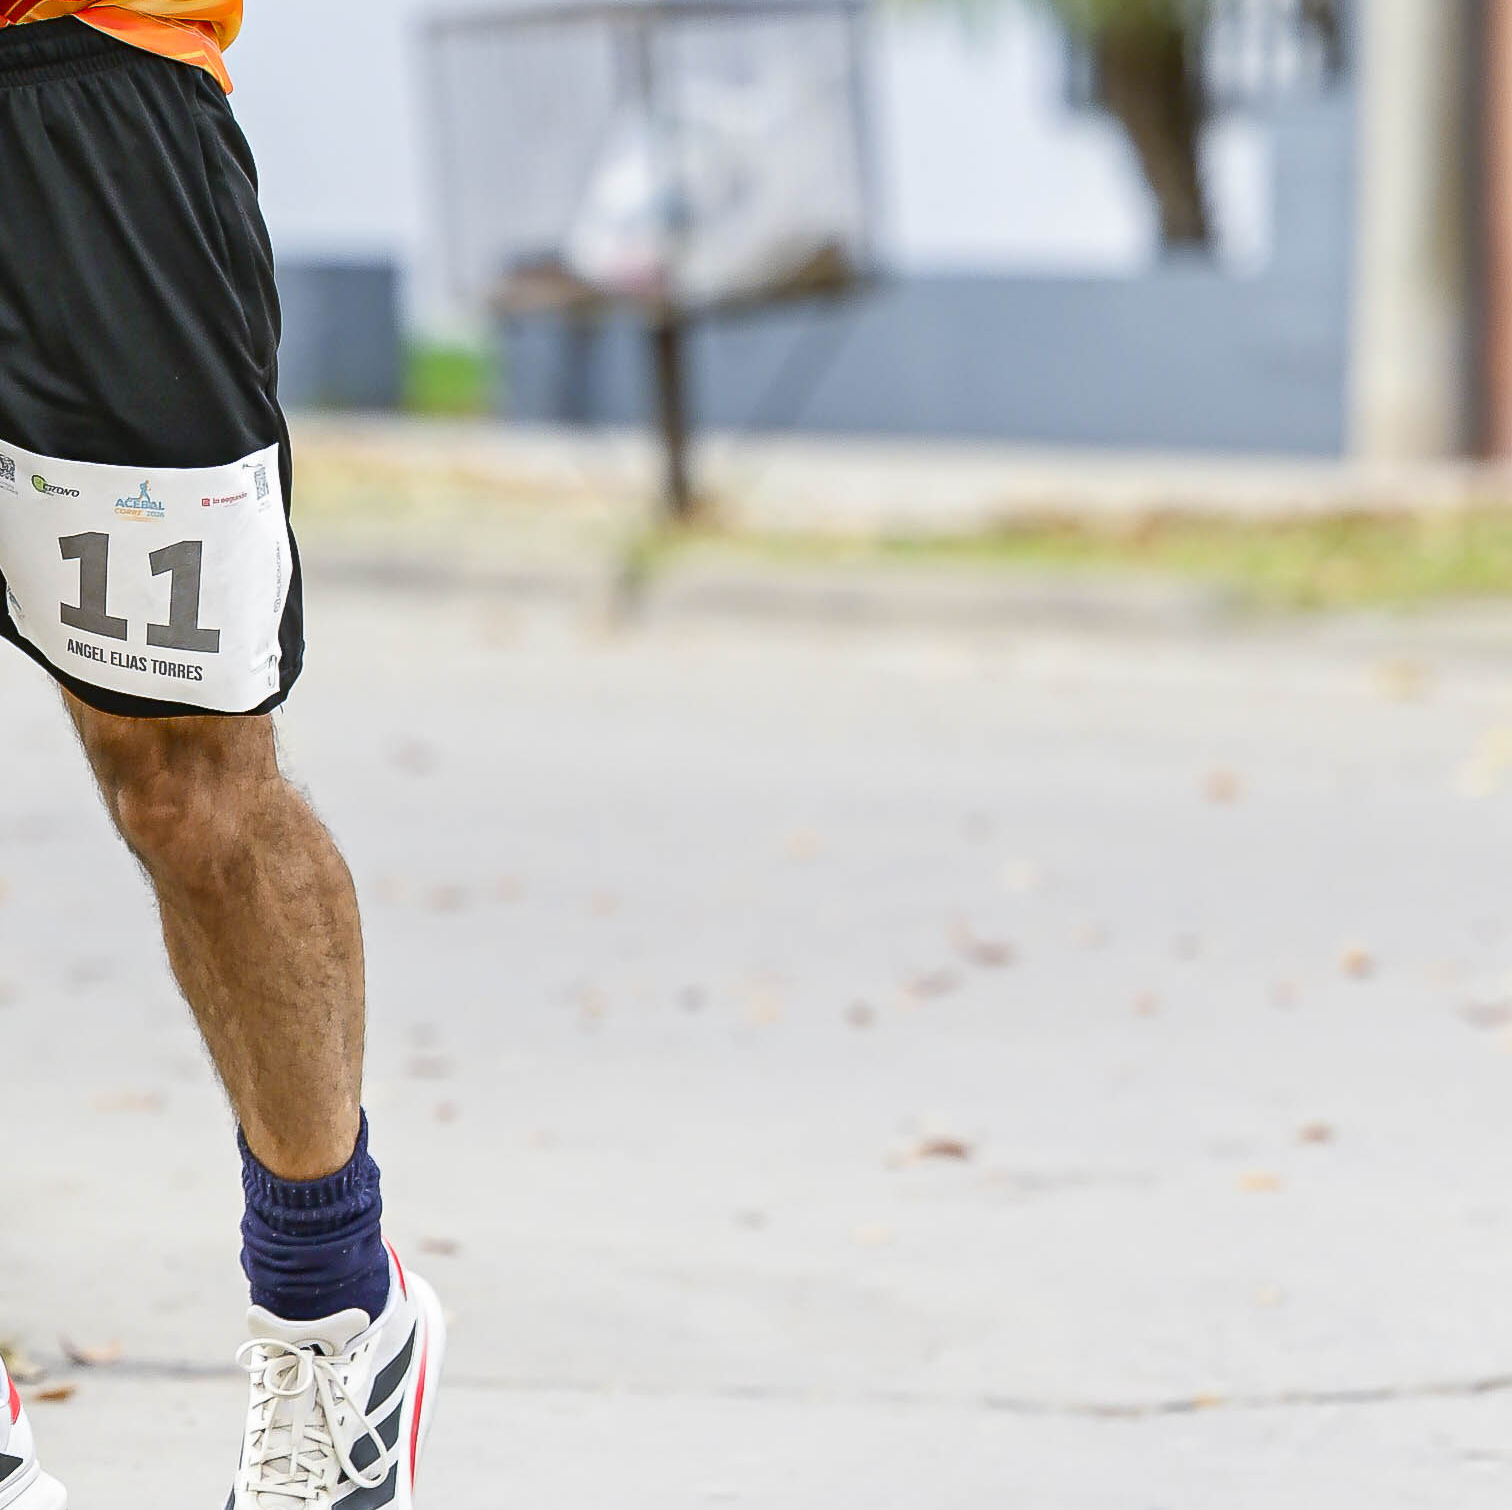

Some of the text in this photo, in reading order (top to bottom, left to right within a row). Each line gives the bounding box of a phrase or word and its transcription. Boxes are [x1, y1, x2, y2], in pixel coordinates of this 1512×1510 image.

[114, 497, 166, 511] ACEBAL
[57, 531, 221, 654] 11
[66, 638, 204, 682] ANGEL ELIAS TORRES
